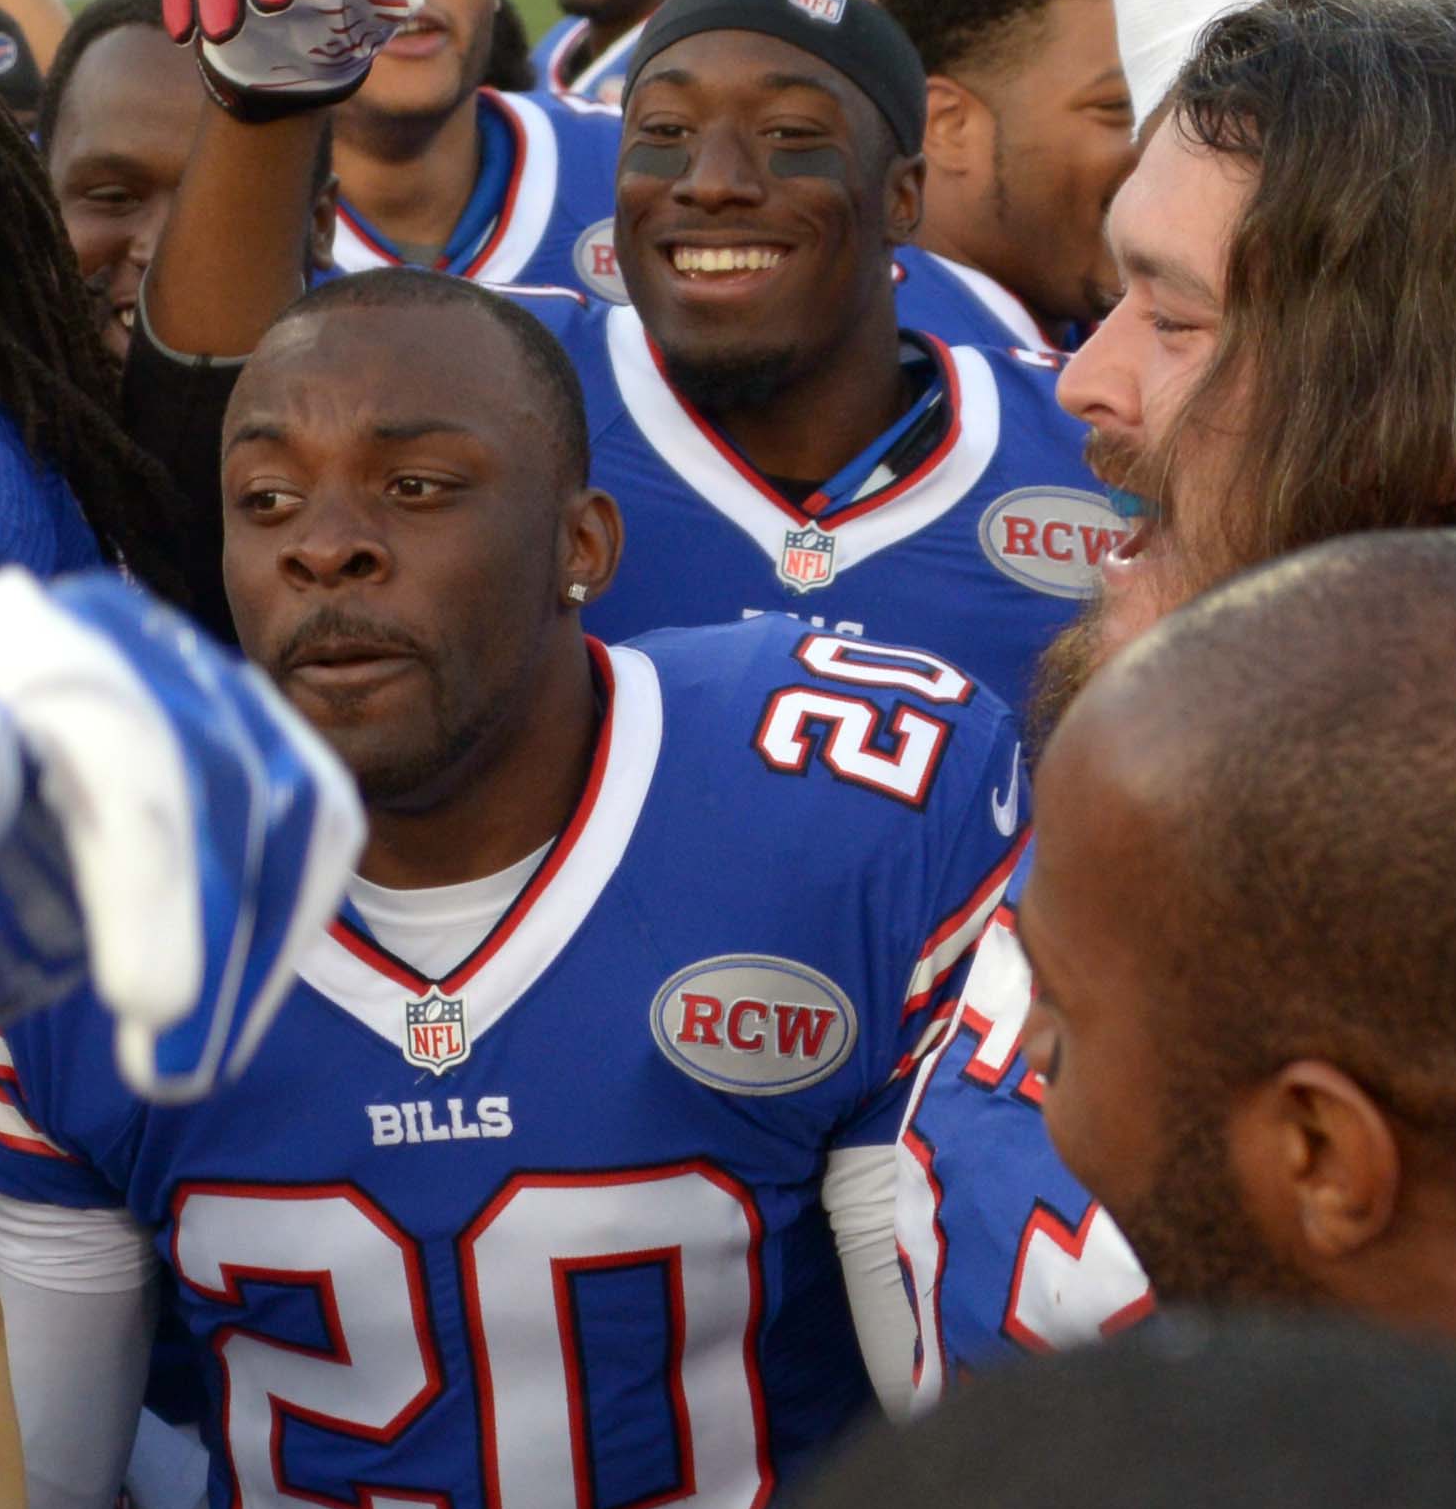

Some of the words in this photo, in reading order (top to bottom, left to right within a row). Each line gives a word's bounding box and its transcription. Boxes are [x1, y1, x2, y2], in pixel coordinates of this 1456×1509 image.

[786, 550, 829, 580] NFL
[754, 630, 972, 810] 20
[411, 1022, 462, 1058] NFL
[675, 993, 837, 1060] RCW
[366, 1095, 513, 1146] BILLS
